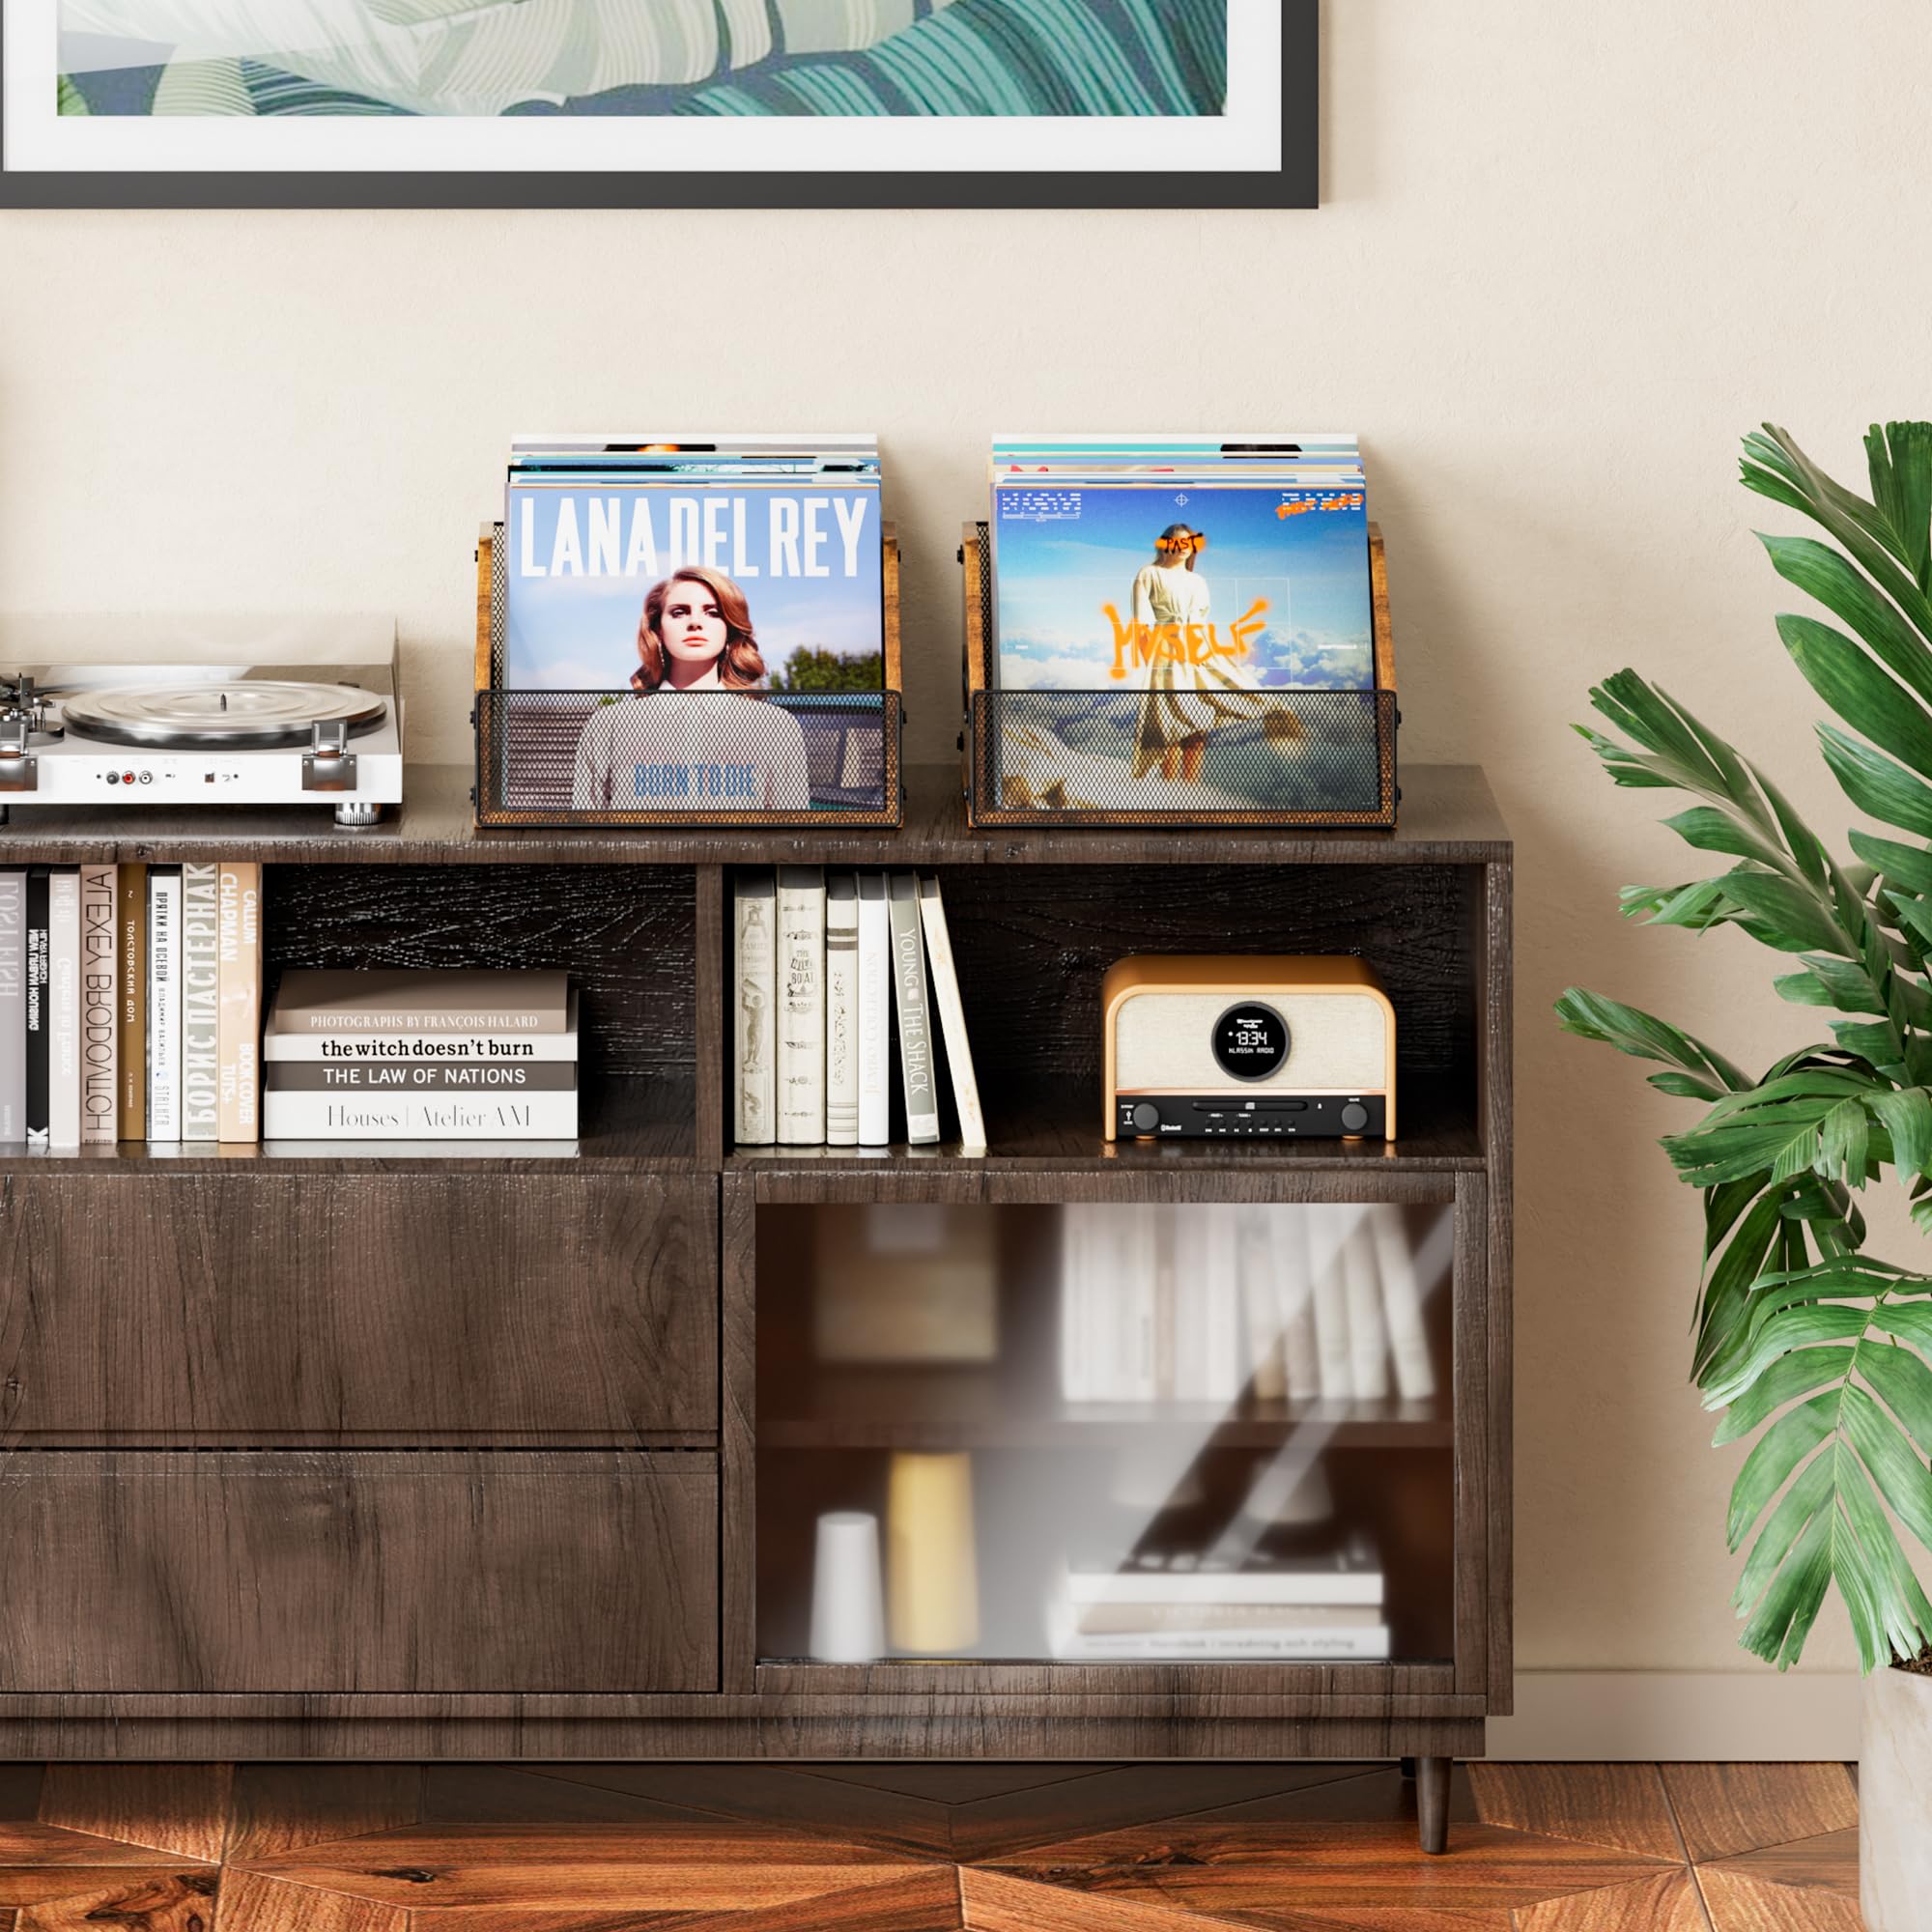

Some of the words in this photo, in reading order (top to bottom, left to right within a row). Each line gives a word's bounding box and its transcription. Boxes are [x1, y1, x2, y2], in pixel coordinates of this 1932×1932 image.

[520, 497, 658, 578] LANA
[669, 497, 759, 578] DEL
[769, 497, 867, 578] REY
[1102, 598, 1268, 679] MYSELF
[156, 931, 168, 943] НА
[220, 872, 238, 962] CHAPMAN
[242, 890, 257, 944] CALLUM
[187, 862, 217, 1025] ПАСТЕРНАК
[899, 927, 919, 987] YOUNG
[310, 1015, 403, 1029] PHOTOGRAPHS
[407, 1015, 420, 1028] BY
[423, 1015, 486, 1031] FRANÇOIS
[488, 1015, 538, 1029] HALARD
[903, 1004, 923, 1037] THE
[1236, 1031, 1267, 1045] 13:34
[240, 1042, 254, 1080] BOOK
[321, 1039, 353, 1056] the
[355, 1039, 410, 1056] witch
[488, 1039, 534, 1056] burn
[906, 1040, 928, 1095] SHACK
[187, 1034, 217, 1124] БОРИС
[323, 1068, 361, 1085] THE
[368, 1068, 408, 1085] LAW
[412, 1068, 438, 1085] OF
[444, 1068, 526, 1085] NATIONS
[240, 1082, 254, 1124] COVER
[328, 1105, 399, 1126] Houses
[419, 1105, 487, 1126] Atelier
[492, 1105, 530, 1126] AM
